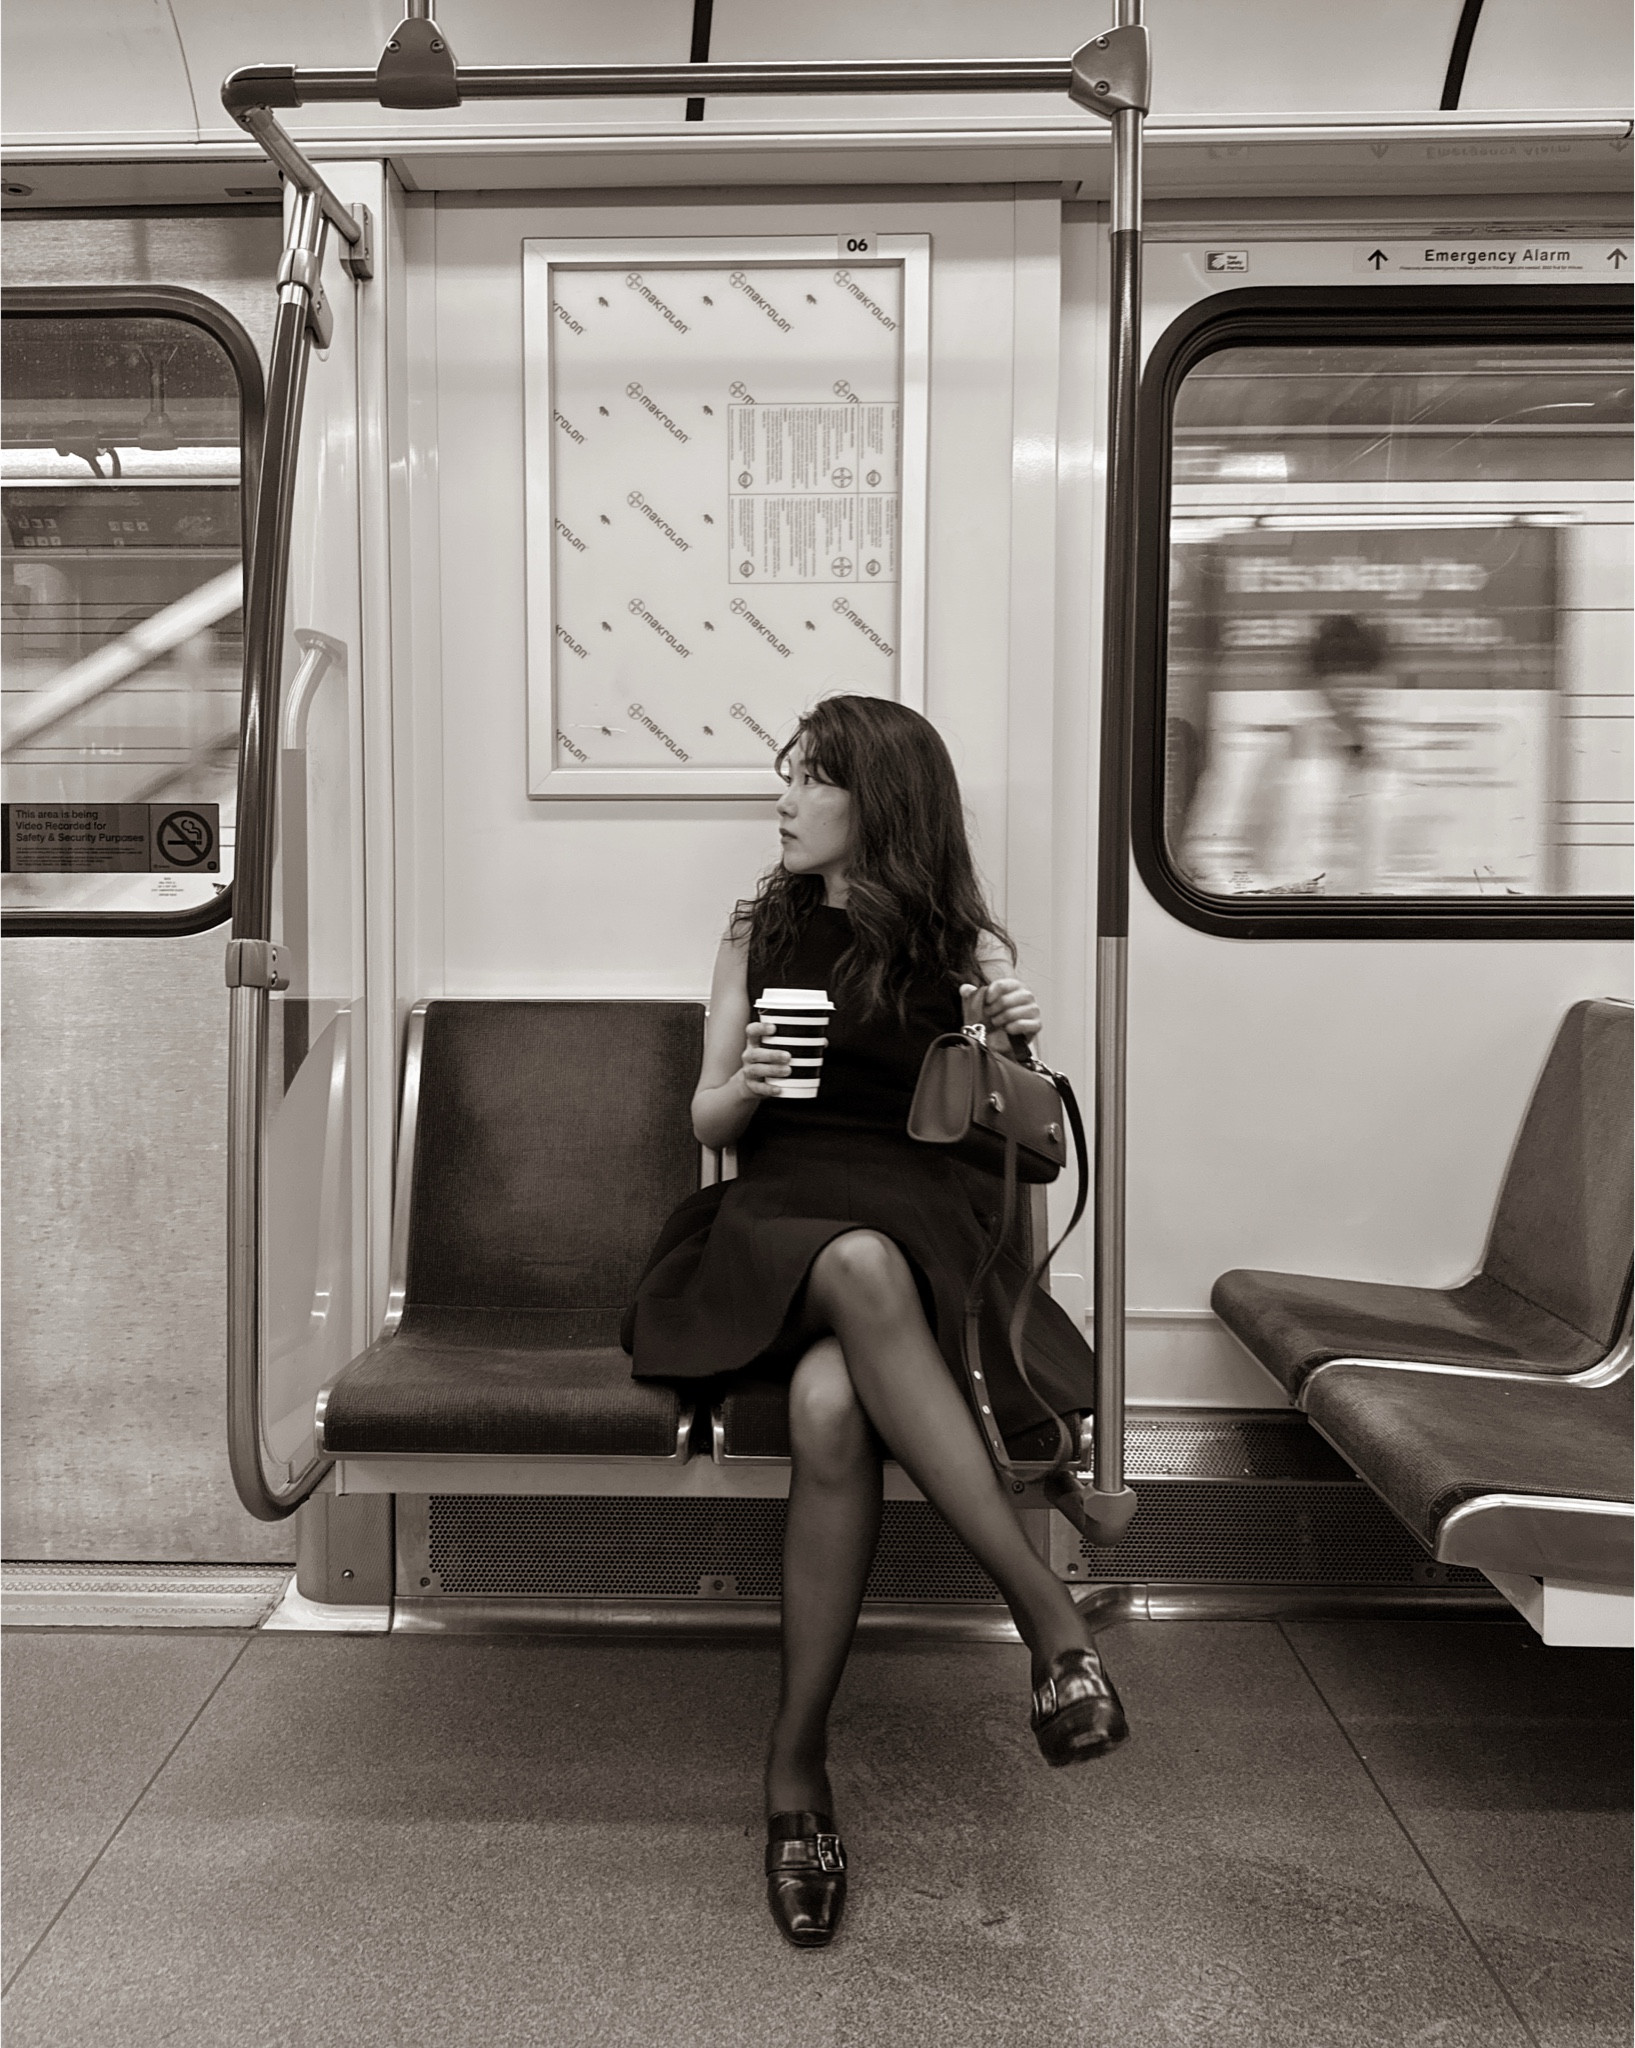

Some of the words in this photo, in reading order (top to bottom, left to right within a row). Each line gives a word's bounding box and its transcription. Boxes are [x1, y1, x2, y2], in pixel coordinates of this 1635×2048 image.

[847, 238, 868, 252] 06
[1424, 249, 1517, 264] Emergency
[1522, 249, 1570, 261] Alarm
[639, 285, 689, 334] makrolon
[743, 284, 792, 333] makrolon
[847, 283, 896, 331] makrolon
[639, 395, 689, 443] makrolon
[640, 503, 690, 552] makrolon
[641, 611, 690, 658] makrolon
[743, 611, 791, 658] makrolon
[845, 610, 894, 657] makrolon
[641, 715, 690, 762] makrolon
[16, 809, 36, 818] This
[61, 809, 69, 818] is
[72, 809, 98, 820] being
[16, 822, 43, 830] Video
[45, 822, 91, 830] Recorded
[94, 821, 107, 830] for
[16, 833, 45, 843] Safety
[48, 833, 55, 841] &
[58, 833, 96, 843] Security
[99, 833, 144, 843] Purposes
